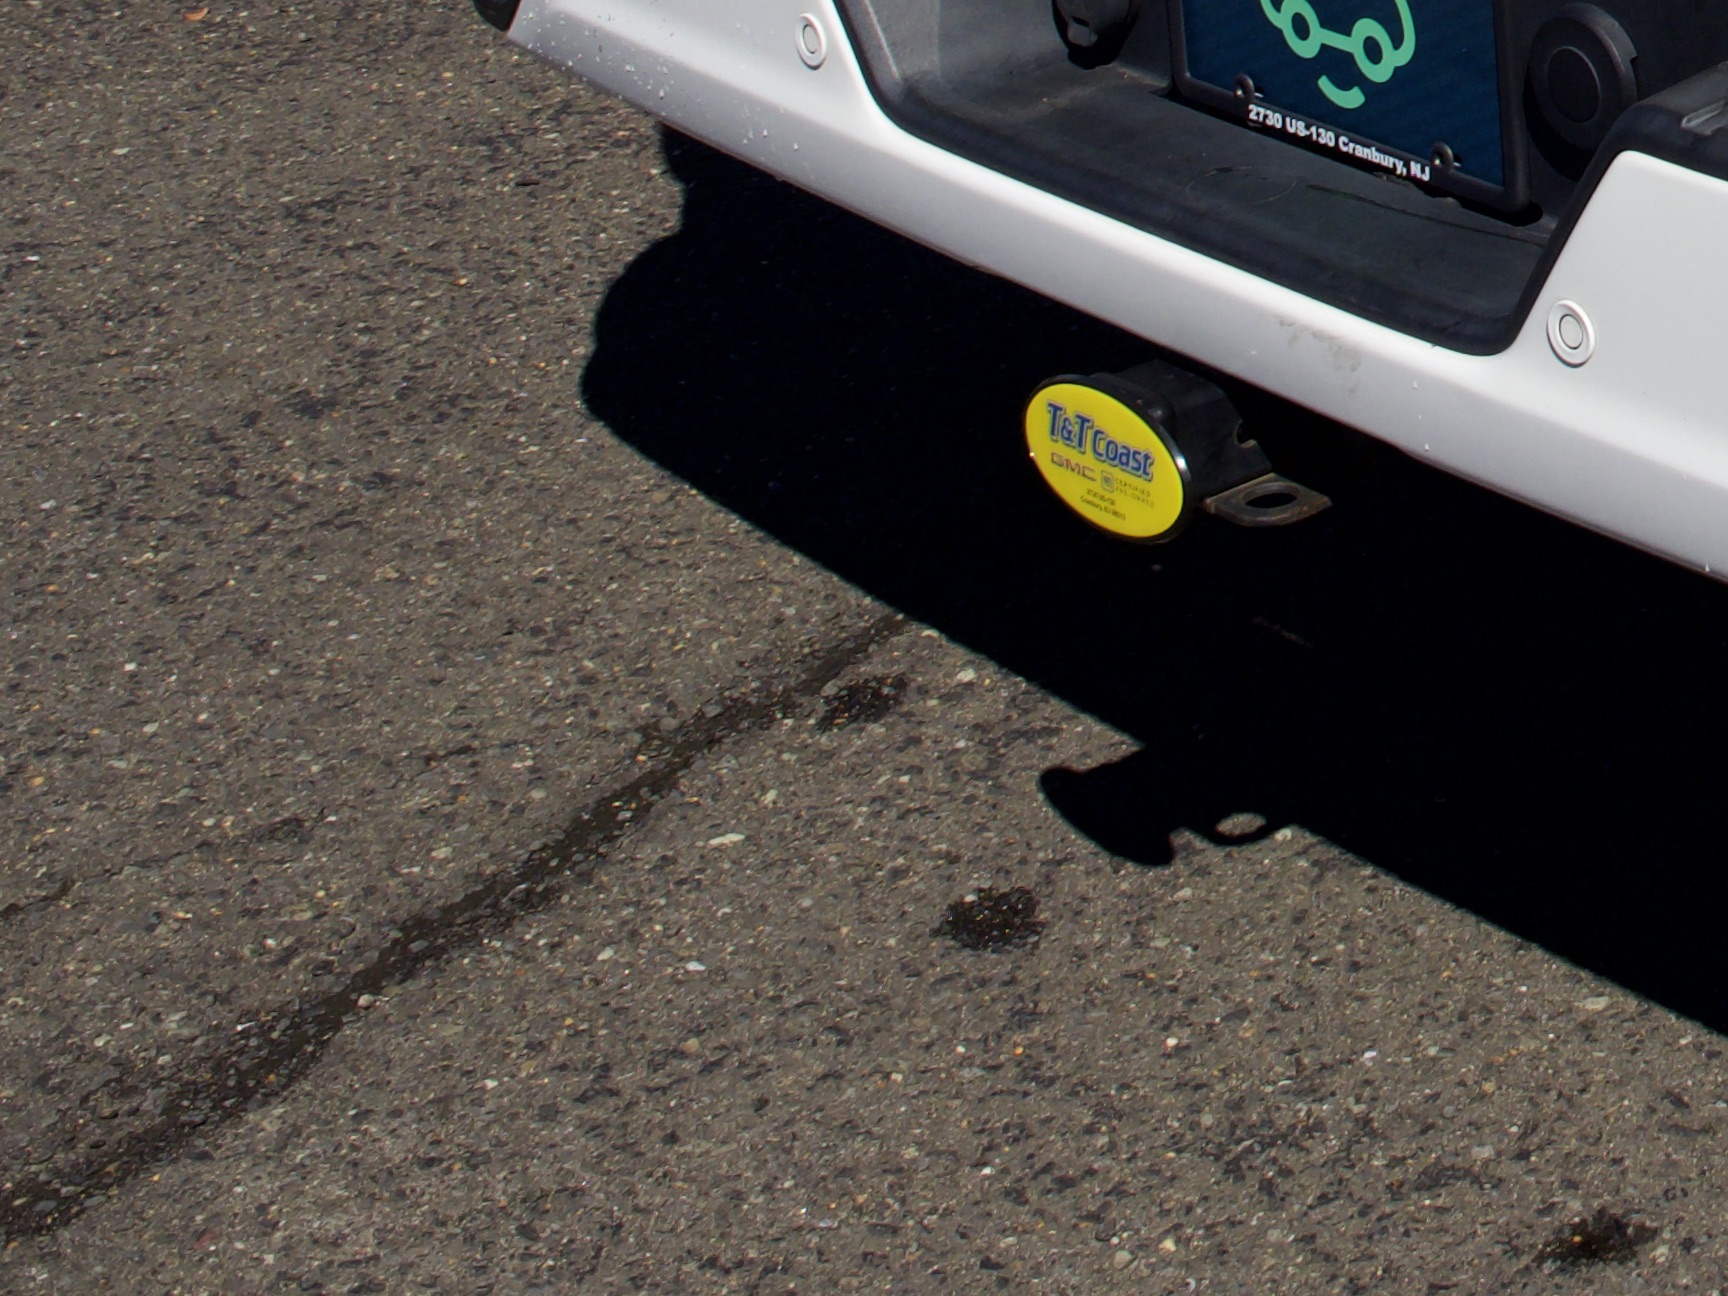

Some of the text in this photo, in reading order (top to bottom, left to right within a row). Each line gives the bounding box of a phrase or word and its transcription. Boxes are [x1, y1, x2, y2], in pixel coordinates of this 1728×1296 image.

[1247, 103, 1430, 182] 2730 US-130 Cranbury, NJ
[1046, 400, 1155, 483] T&T Coast
[1050, 451, 1097, 482] GMC
